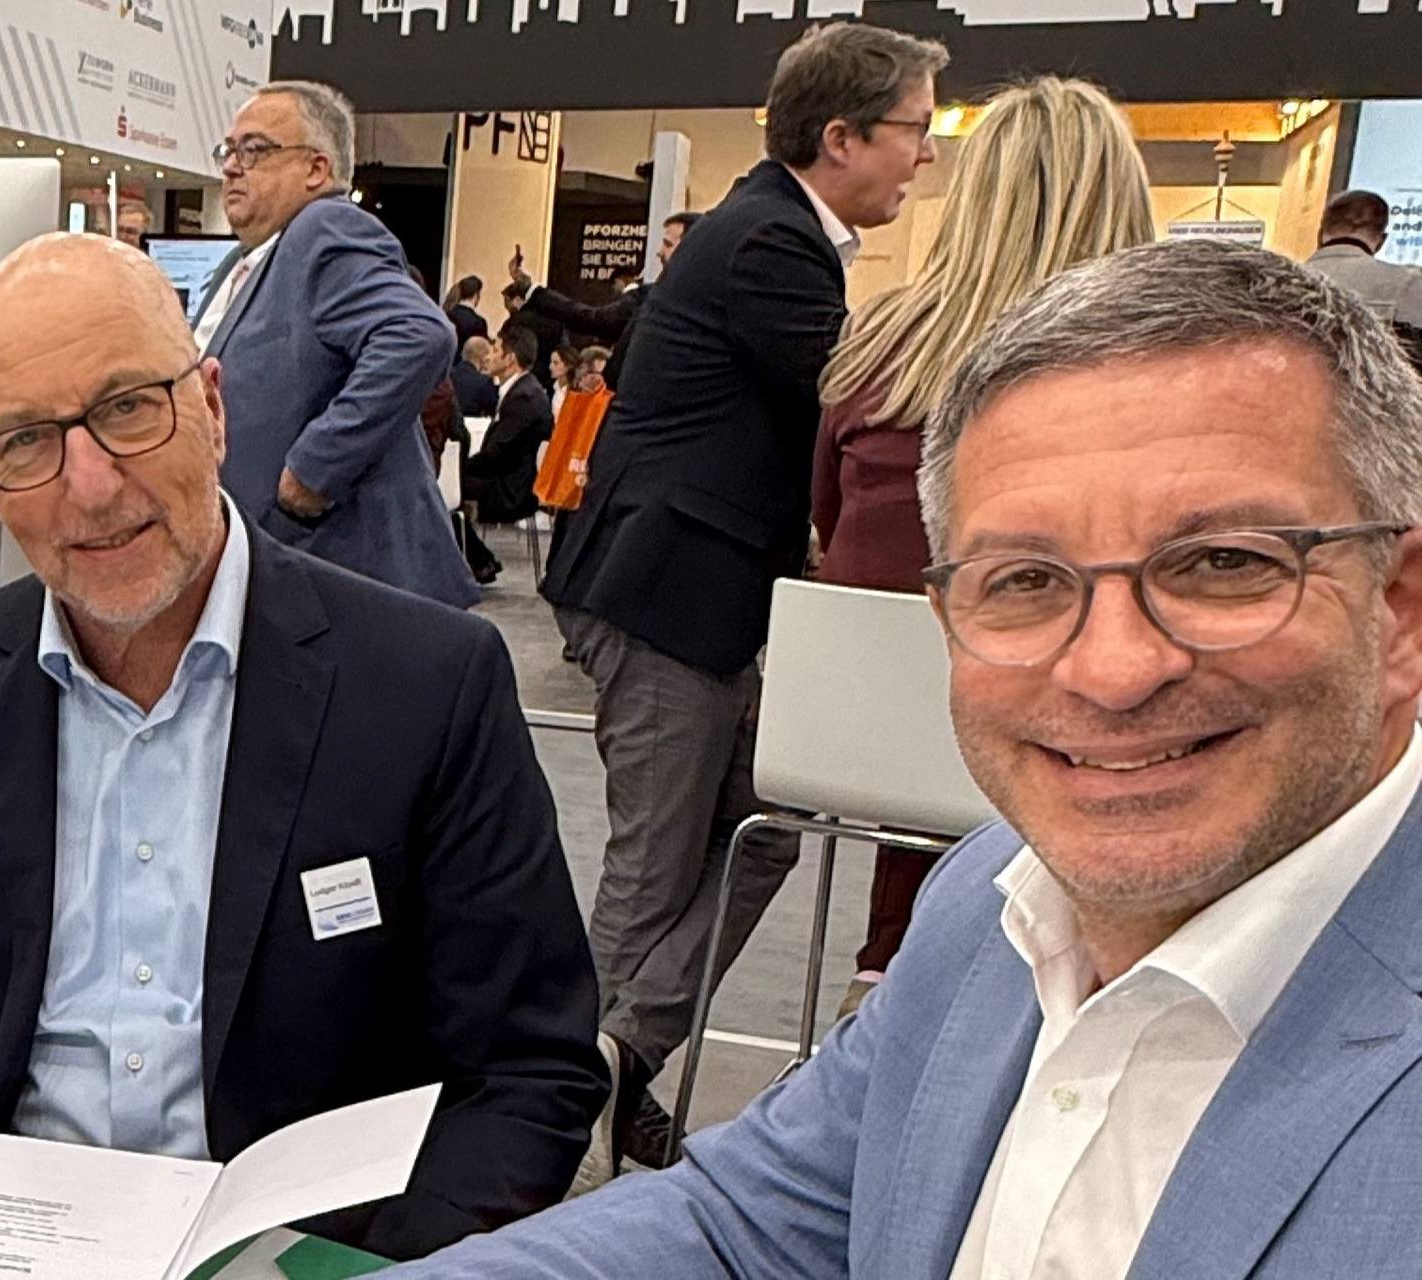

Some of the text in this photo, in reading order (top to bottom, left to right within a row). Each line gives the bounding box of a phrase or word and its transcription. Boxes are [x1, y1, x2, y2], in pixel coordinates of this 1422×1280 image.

[582, 239, 643, 252] BRINGEN
[581, 253, 637, 267] SIE SICH
[580, 267, 596, 280] IN
